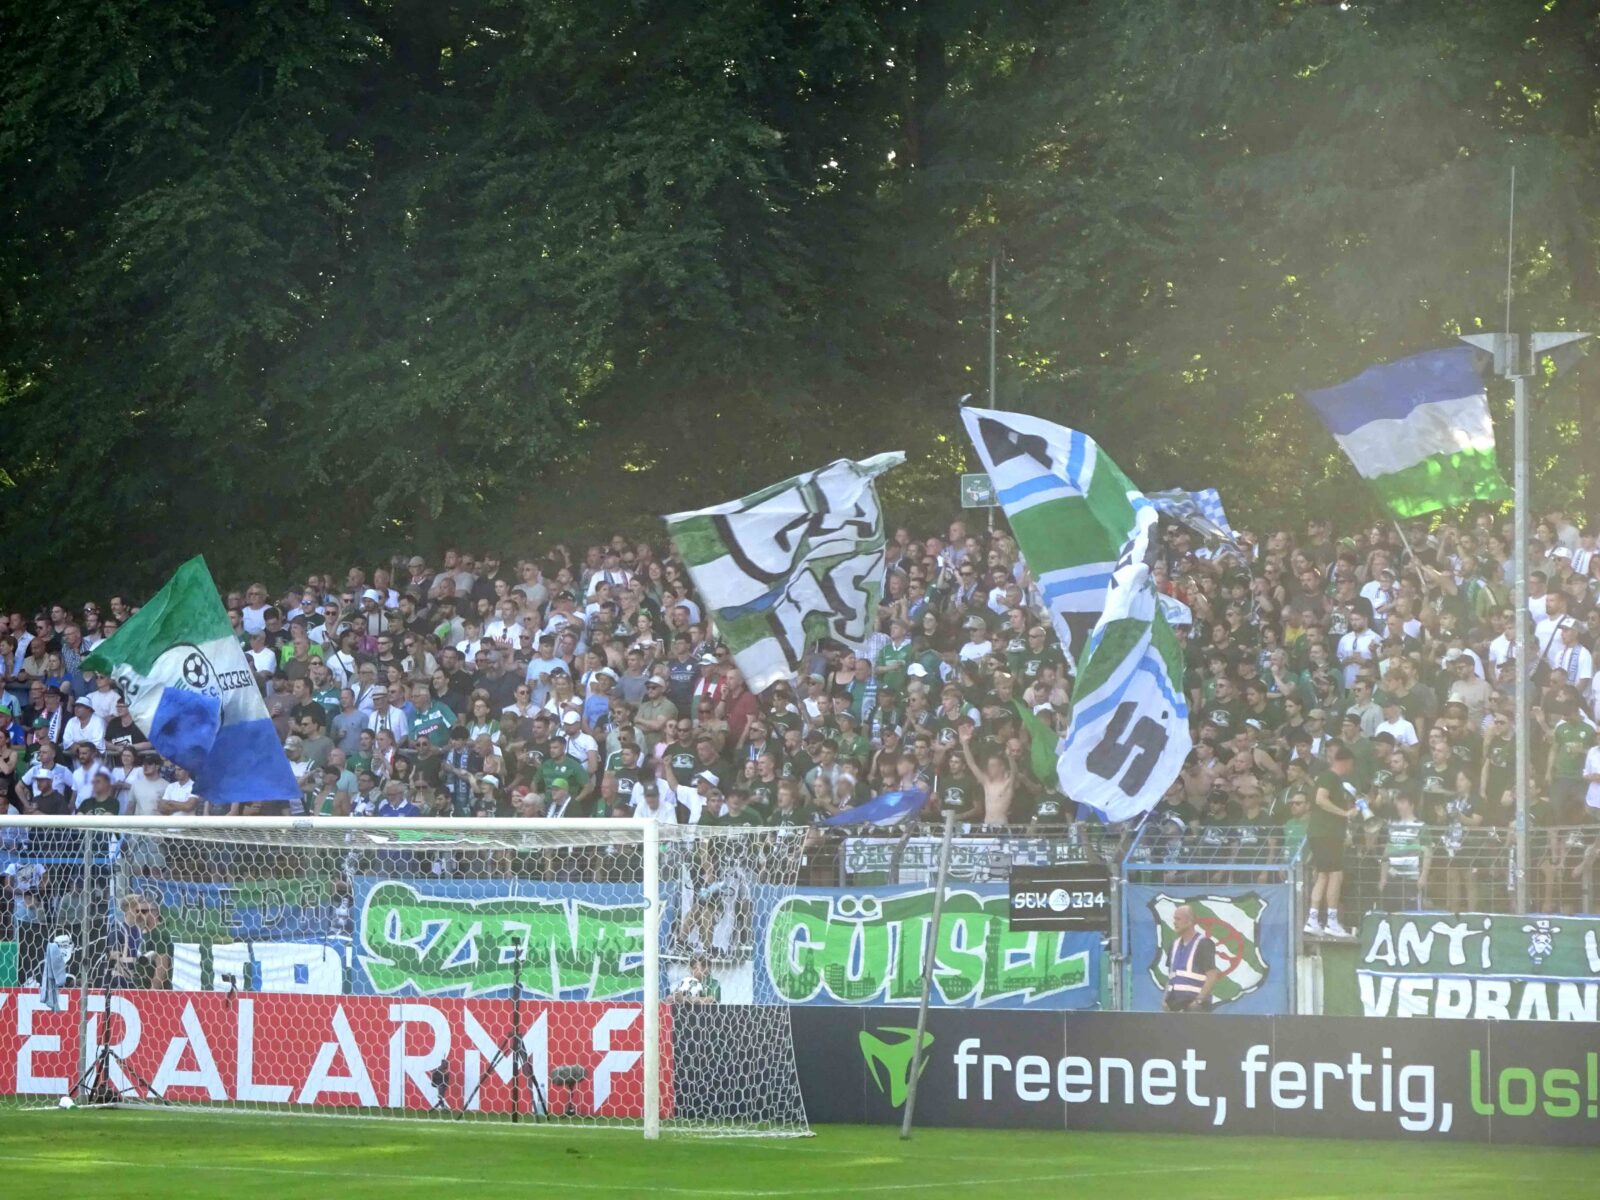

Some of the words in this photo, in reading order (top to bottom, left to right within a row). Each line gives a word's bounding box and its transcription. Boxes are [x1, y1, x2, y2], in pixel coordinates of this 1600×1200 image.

[1014, 892, 1047, 908] SEK
[1072, 892, 1105, 908] 334
[0, 993, 548, 1114] ERALARM
[953, 1038, 1227, 1126] freenet,
[1240, 1045, 1453, 1133] fertig,
[1469, 1049, 1599, 1118] los!
